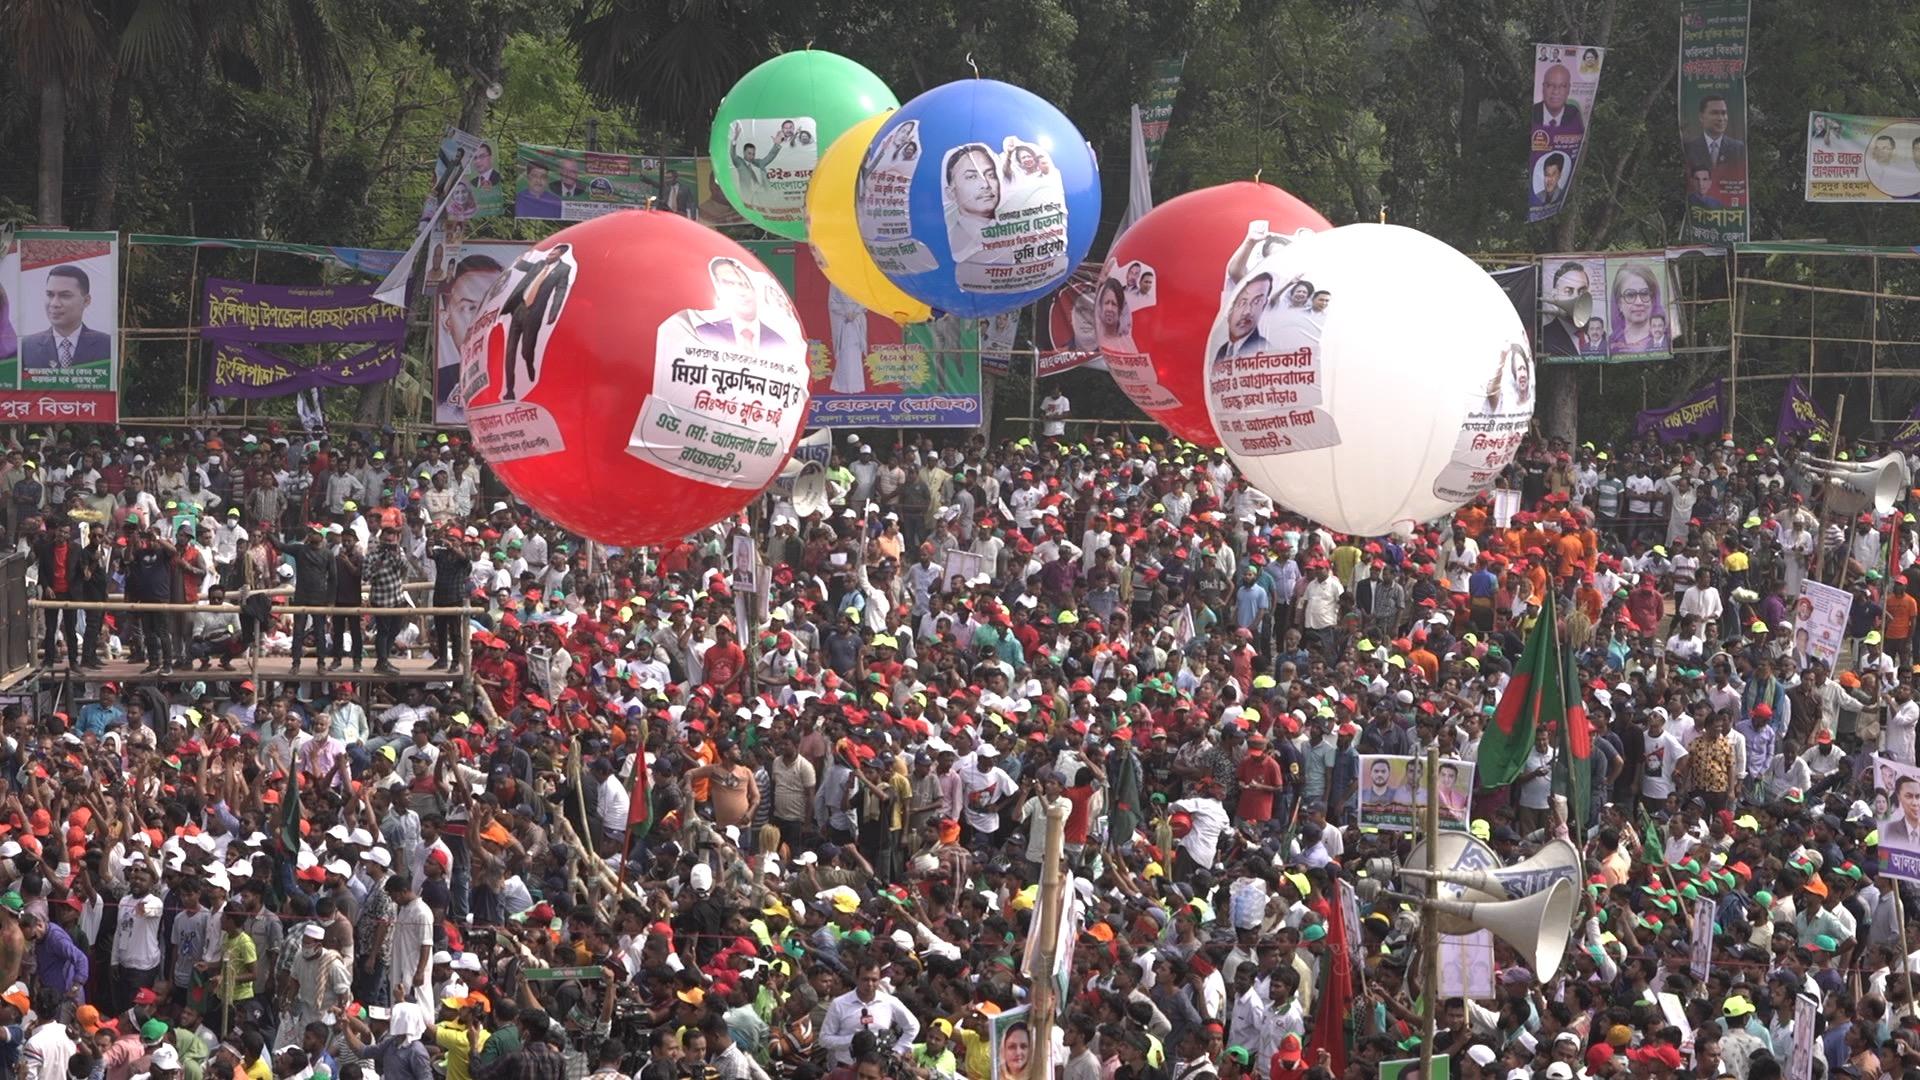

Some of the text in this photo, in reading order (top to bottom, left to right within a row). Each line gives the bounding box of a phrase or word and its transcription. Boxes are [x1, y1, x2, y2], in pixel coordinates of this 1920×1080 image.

[980, 212, 1064, 239] আমাদের চেতনা
[1013, 244, 1035, 265] তুমি
[985, 267, 1013, 278] শামা
[259, 300, 308, 329] উপজেলা
[1234, 346, 1313, 371] পদদলিতকারী
[671, 358, 708, 385] মিয়া
[1239, 371, 1316, 390] আগ্রাসনবাদের
[37, 397, 97, 417] বিভাগ
[825, 399, 895, 412] হোসেন
[1265, 386, 1299, 406] দাঁড়াও
[505, 406, 538, 426] সেলিম
[693, 390, 784, 429] নিঃশর্ত মুক্তি চাই
[1245, 415, 1290, 432] আসলাম
[1289, 410, 1317, 428] মিয়া
[710, 431, 757, 456] আসলাম
[755, 436, 779, 459] মিয়া
[1890, 852, 1920, 878] আলহা
